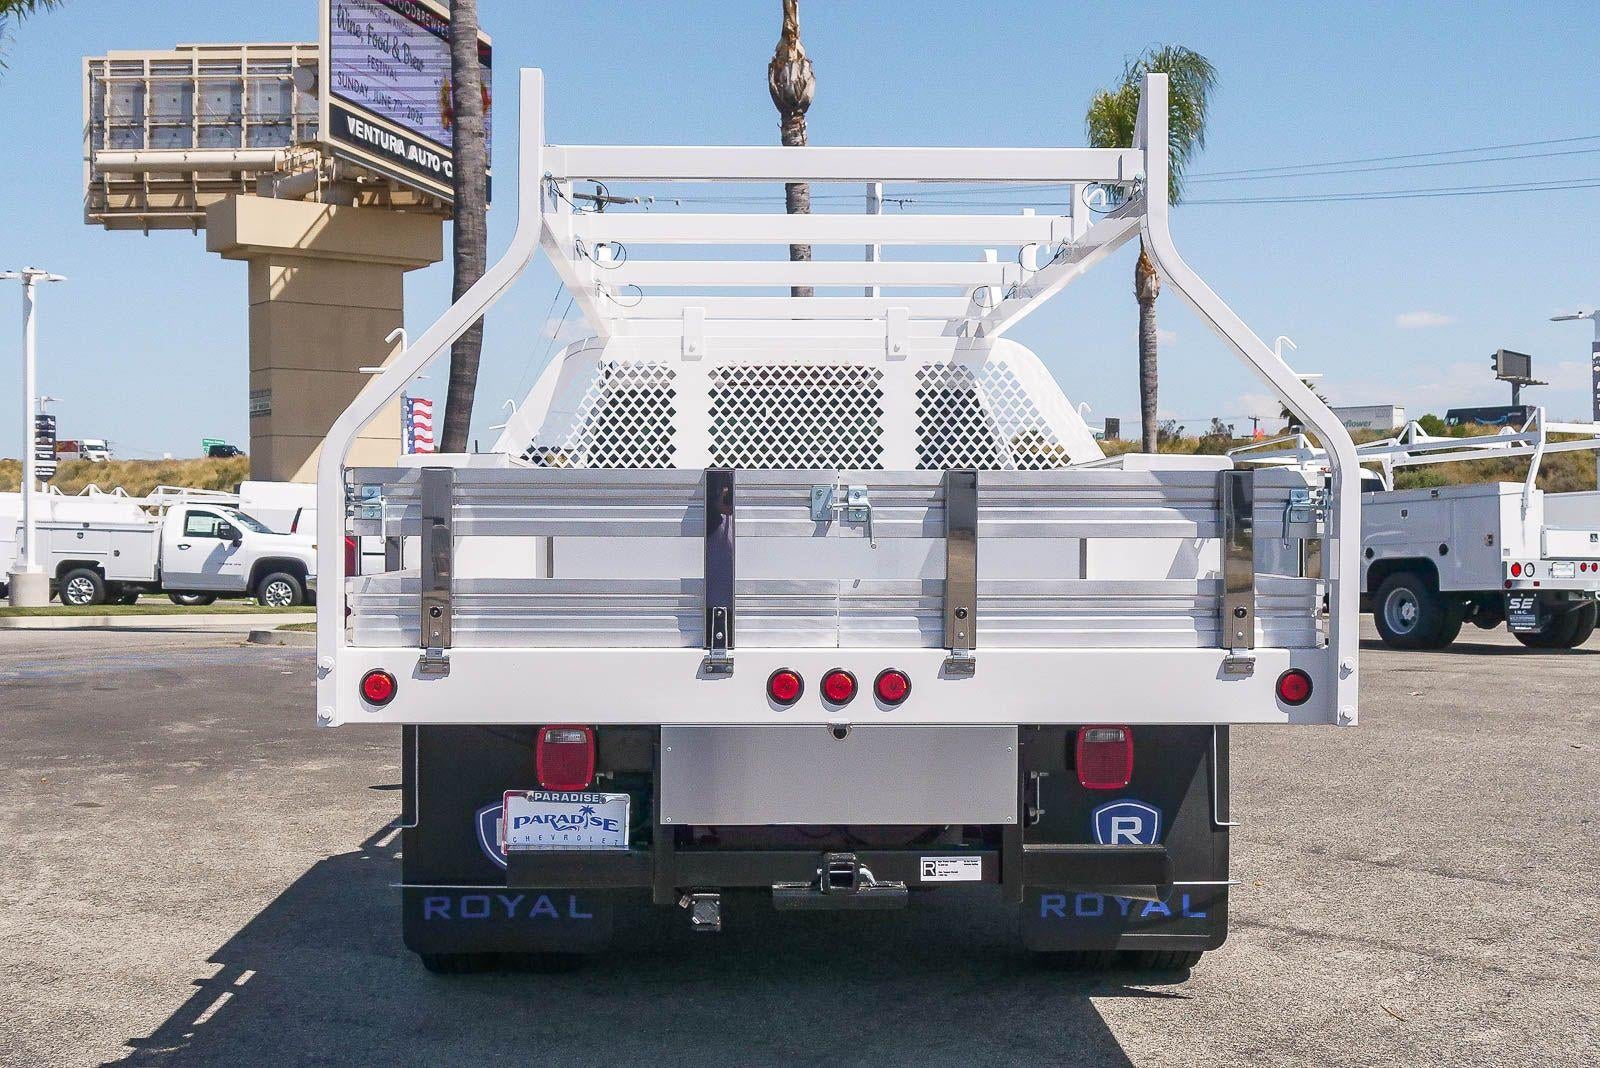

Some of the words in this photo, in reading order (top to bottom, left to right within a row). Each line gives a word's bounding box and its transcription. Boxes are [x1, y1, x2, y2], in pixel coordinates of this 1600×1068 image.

[366, 22, 390, 54] Food
[392, 36, 401, 62] &
[367, 55, 398, 81] FESTIVAL
[372, 88, 392, 110] JUNE
[346, 115, 406, 157] VENTURA
[406, 145, 440, 172] AUTO
[1509, 598, 1534, 609] SE
[534, 792, 599, 802] PARADISE
[513, 805, 619, 832] PARADISE
[1111, 816, 1143, 844] R
[923, 861, 936, 876] R
[424, 894, 593, 920] ROYAL
[1040, 893, 1207, 918] ROYAL
